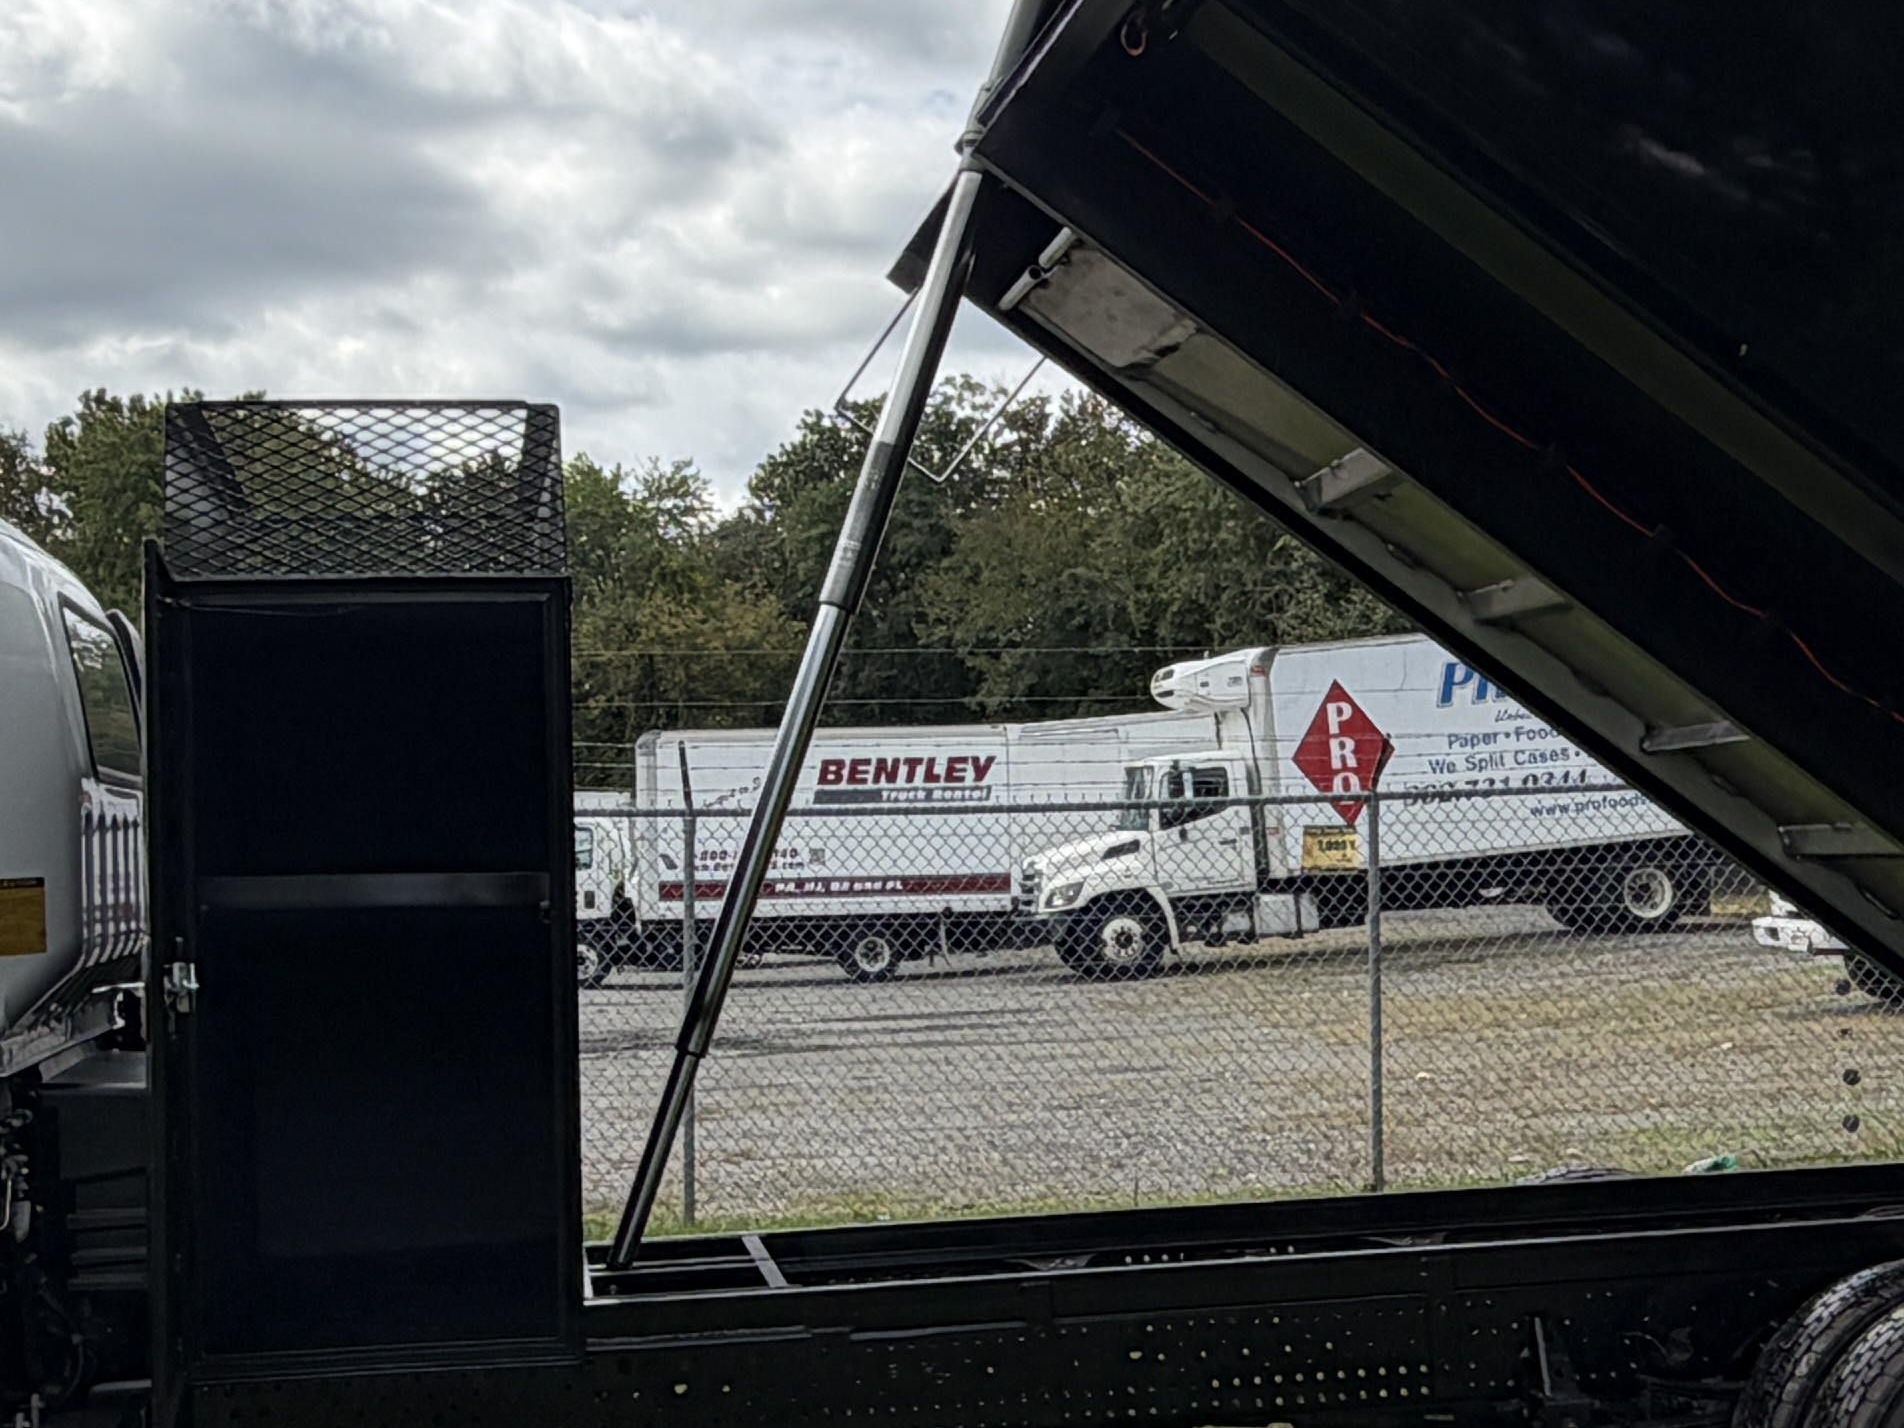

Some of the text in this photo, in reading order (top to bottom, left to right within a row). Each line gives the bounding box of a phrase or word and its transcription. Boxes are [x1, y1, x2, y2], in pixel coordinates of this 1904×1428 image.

[1326, 701, 1361, 805] PRO
[1448, 731, 1498, 750] Paper
[817, 756, 997, 785] BENTLEY
[1428, 747, 1570, 774] We Split Cases
[881, 788, 988, 802] Truck Rental
